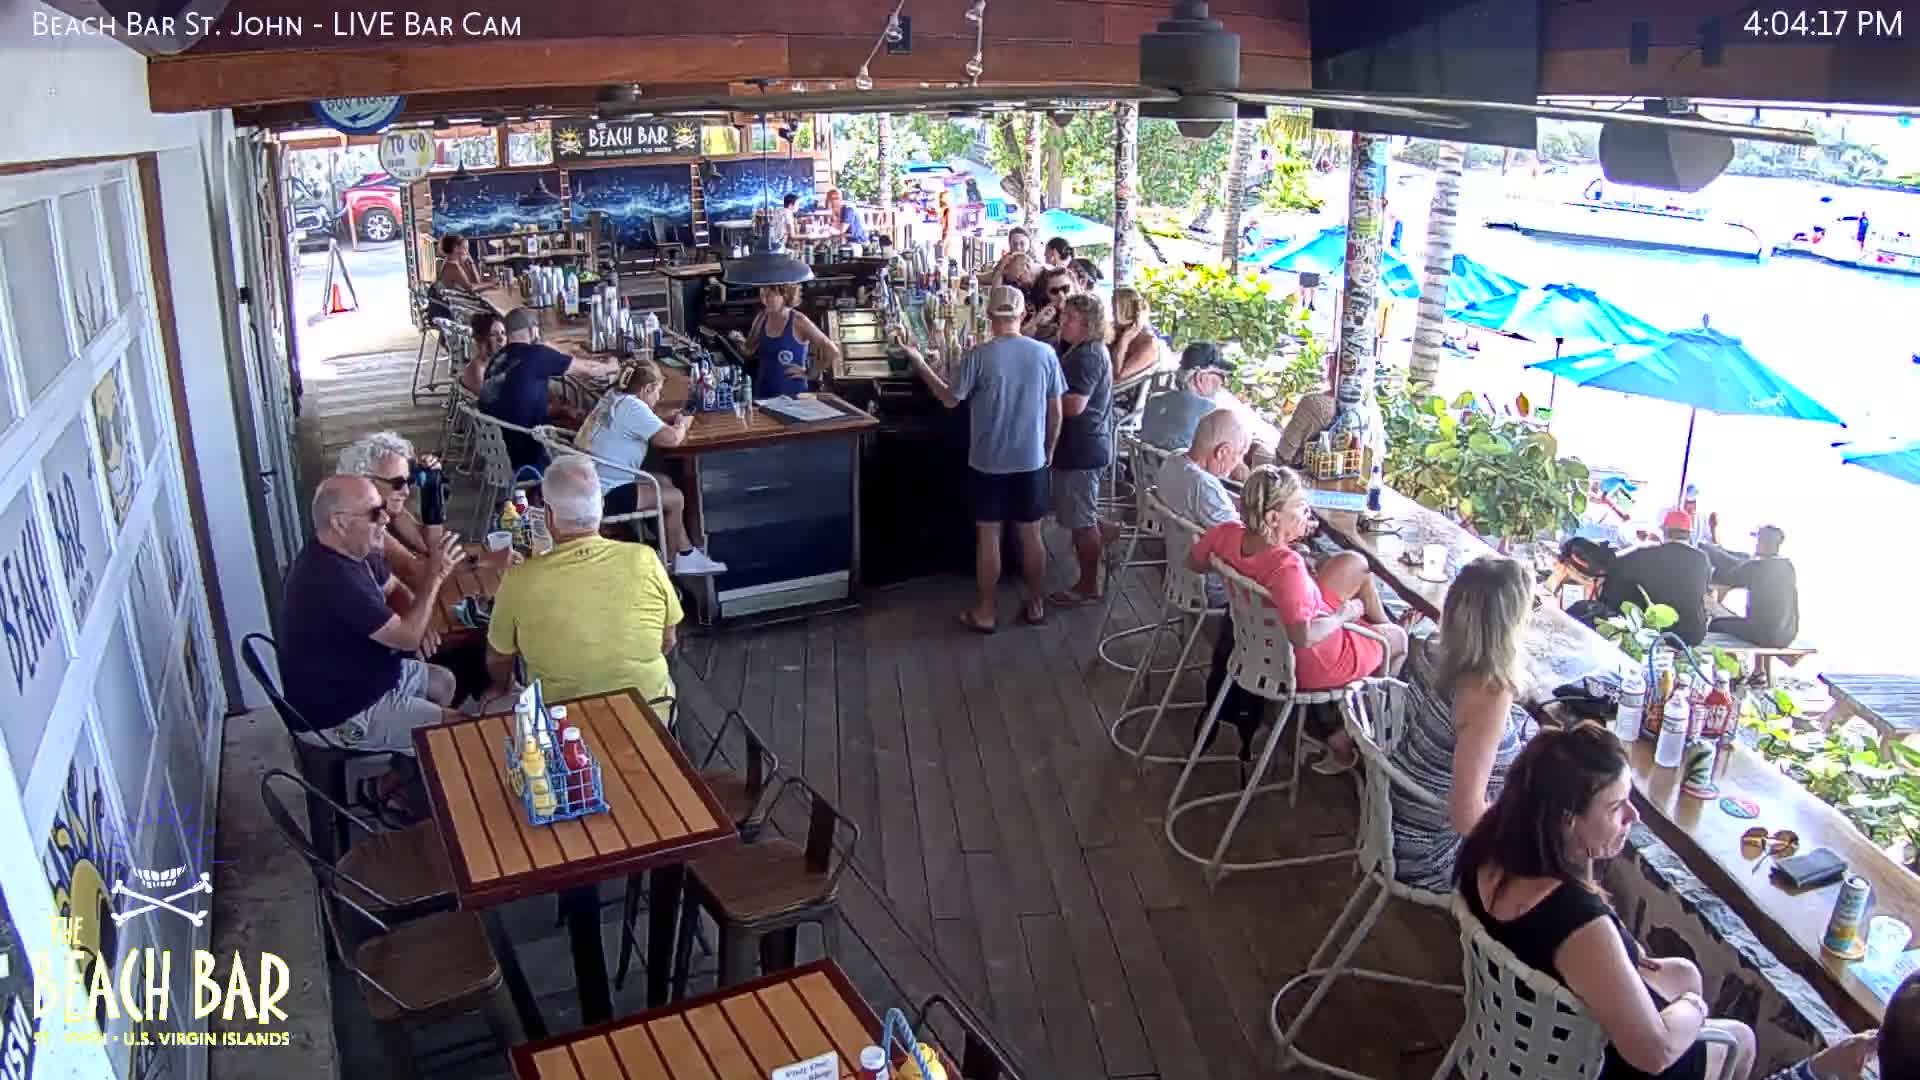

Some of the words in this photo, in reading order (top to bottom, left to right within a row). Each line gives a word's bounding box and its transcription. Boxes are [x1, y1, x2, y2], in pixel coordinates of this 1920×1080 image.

[386, 135, 405, 154] TO
[408, 133, 426, 152] GO
[588, 128, 632, 147] BEACH
[637, 125, 669, 145] BAR
